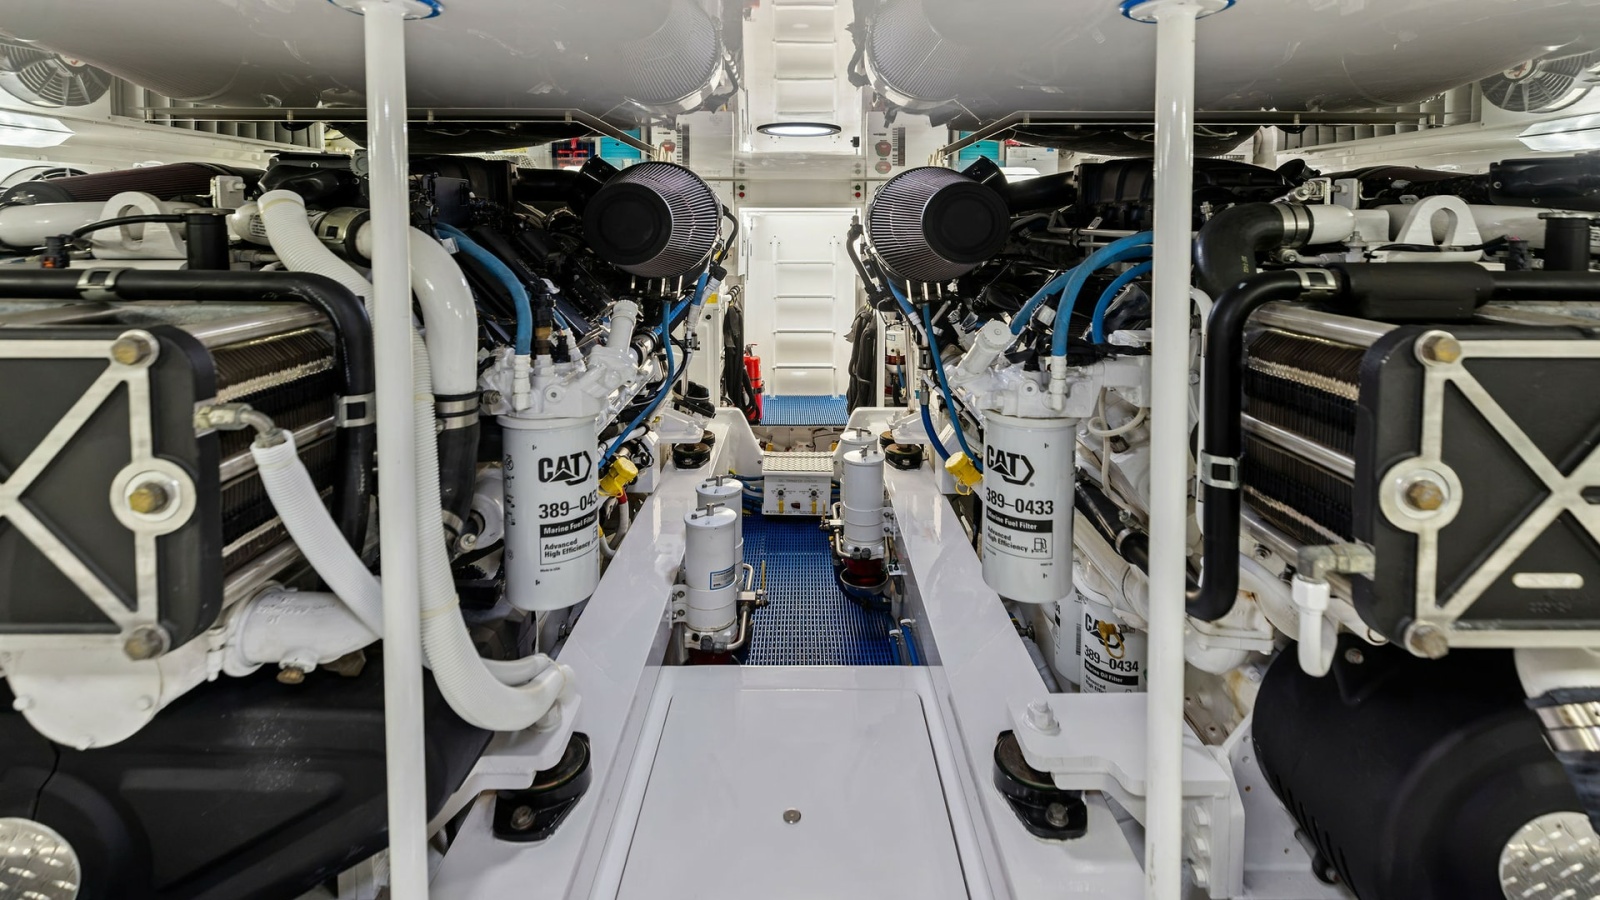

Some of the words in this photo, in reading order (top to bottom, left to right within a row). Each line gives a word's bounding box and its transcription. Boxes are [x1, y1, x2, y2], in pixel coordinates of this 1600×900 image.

[538, 451, 584, 483] CAT
[987, 444, 1020, 478] CAT
[538, 489, 598, 519] 389-043
[986, 486, 1054, 515] 389-0433
[543, 527, 569, 535] Marine
[570, 520, 583, 530] Fuel
[987, 525, 1011, 541] Advanced
[1004, 518, 1018, 527] Fuel
[1019, 521, 1038, 530] Filter
[544, 538, 578, 550] Advanced
[544, 550, 561, 559] High
[562, 540, 591, 555] Efficiency
[997, 538, 1028, 553] Efficiency
[1084, 644, 1139, 673] 389-0434
